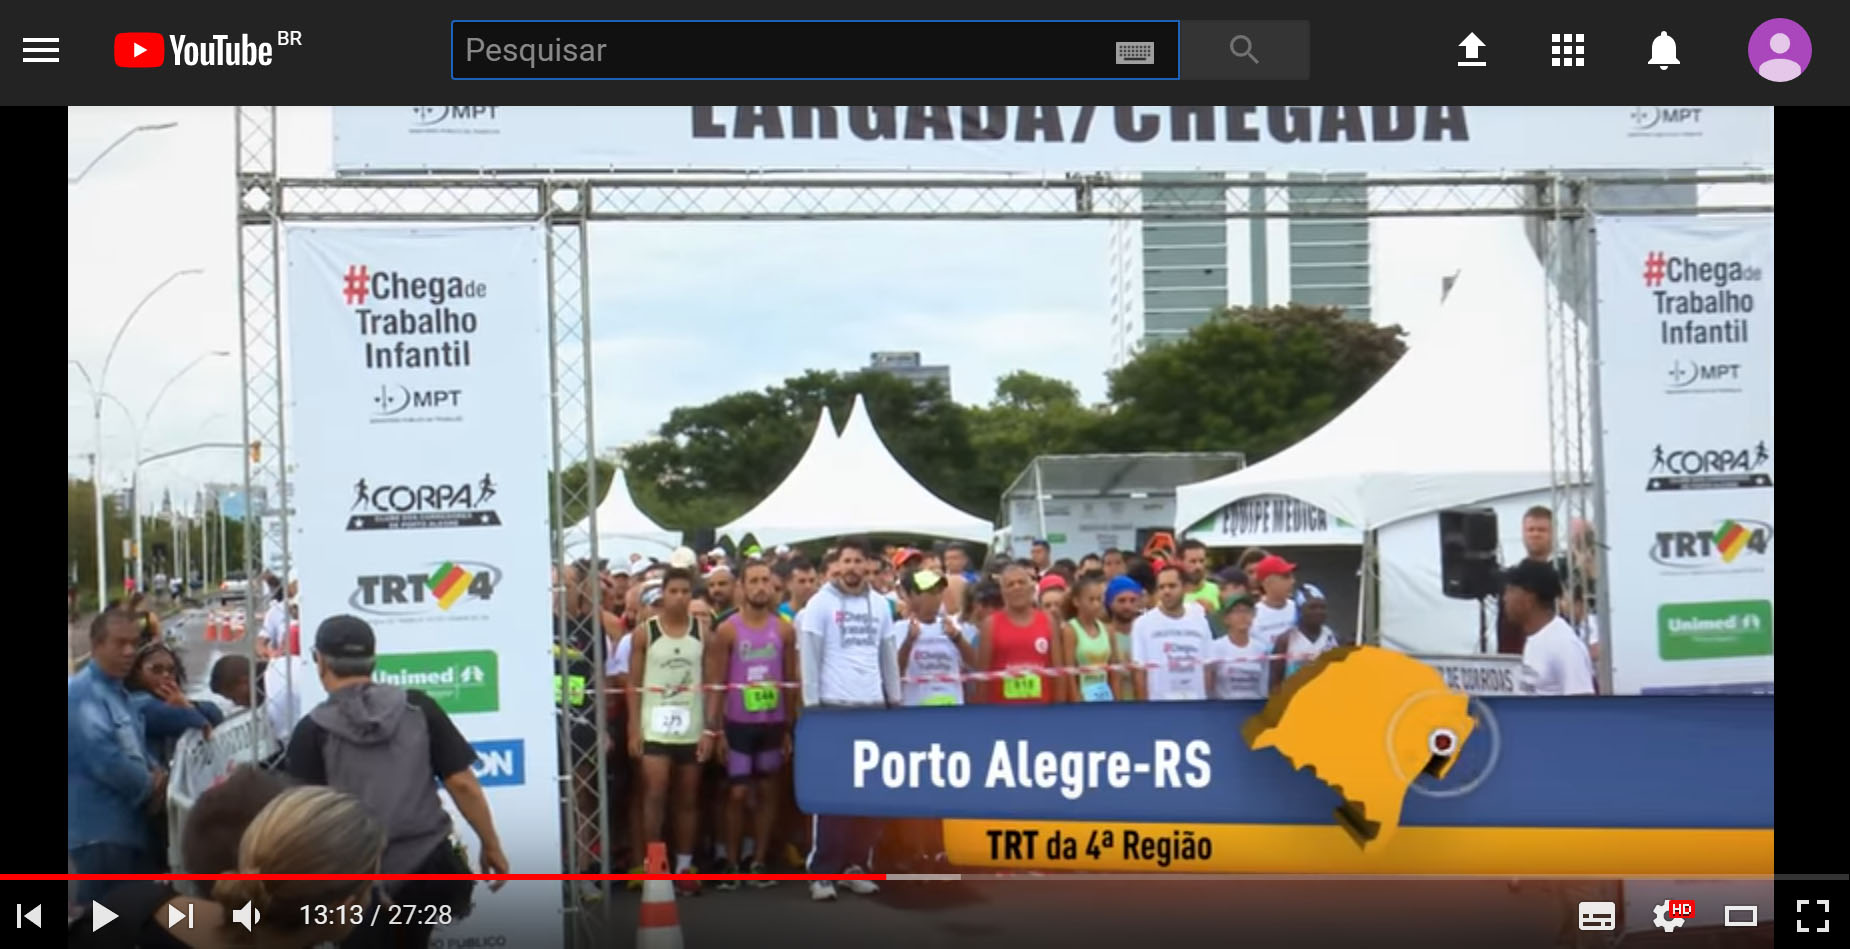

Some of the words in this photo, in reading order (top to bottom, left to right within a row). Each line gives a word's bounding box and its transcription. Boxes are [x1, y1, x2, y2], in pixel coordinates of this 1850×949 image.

[169, 33, 273, 67] YouTube
[277, 30, 303, 46] BR
[465, 37, 607, 68] Pesquisar
[451, 106, 498, 120] MPT
[1661, 107, 1703, 123] MPT
[1643, 251, 1742, 287] #Chega
[1743, 266, 1762, 281] de
[343, 264, 463, 305] #Chega
[464, 280, 487, 298] de
[1653, 289, 1754, 314] Trabalho
[355, 307, 477, 335] Trabalho
[1661, 319, 1748, 345] Infantil
[365, 340, 470, 369] Infantil
[1700, 364, 1741, 379] MPT
[413, 390, 461, 407] MPT
[1666, 448, 1750, 475] CORPA
[371, 484, 472, 512] CORPA
[1656, 530, 1714, 559] TRT
[1745, 528, 1767, 555] 4
[357, 573, 429, 605] TRT
[467, 571, 494, 600] 4
[1668, 614, 1737, 632] Unimed
[372, 664, 454, 686] Unimed
[299, 904, 364, 926] 13:13
[370, 904, 382, 927] /
[387, 904, 453, 926] 27:28
[1672, 903, 1692, 915] HD
